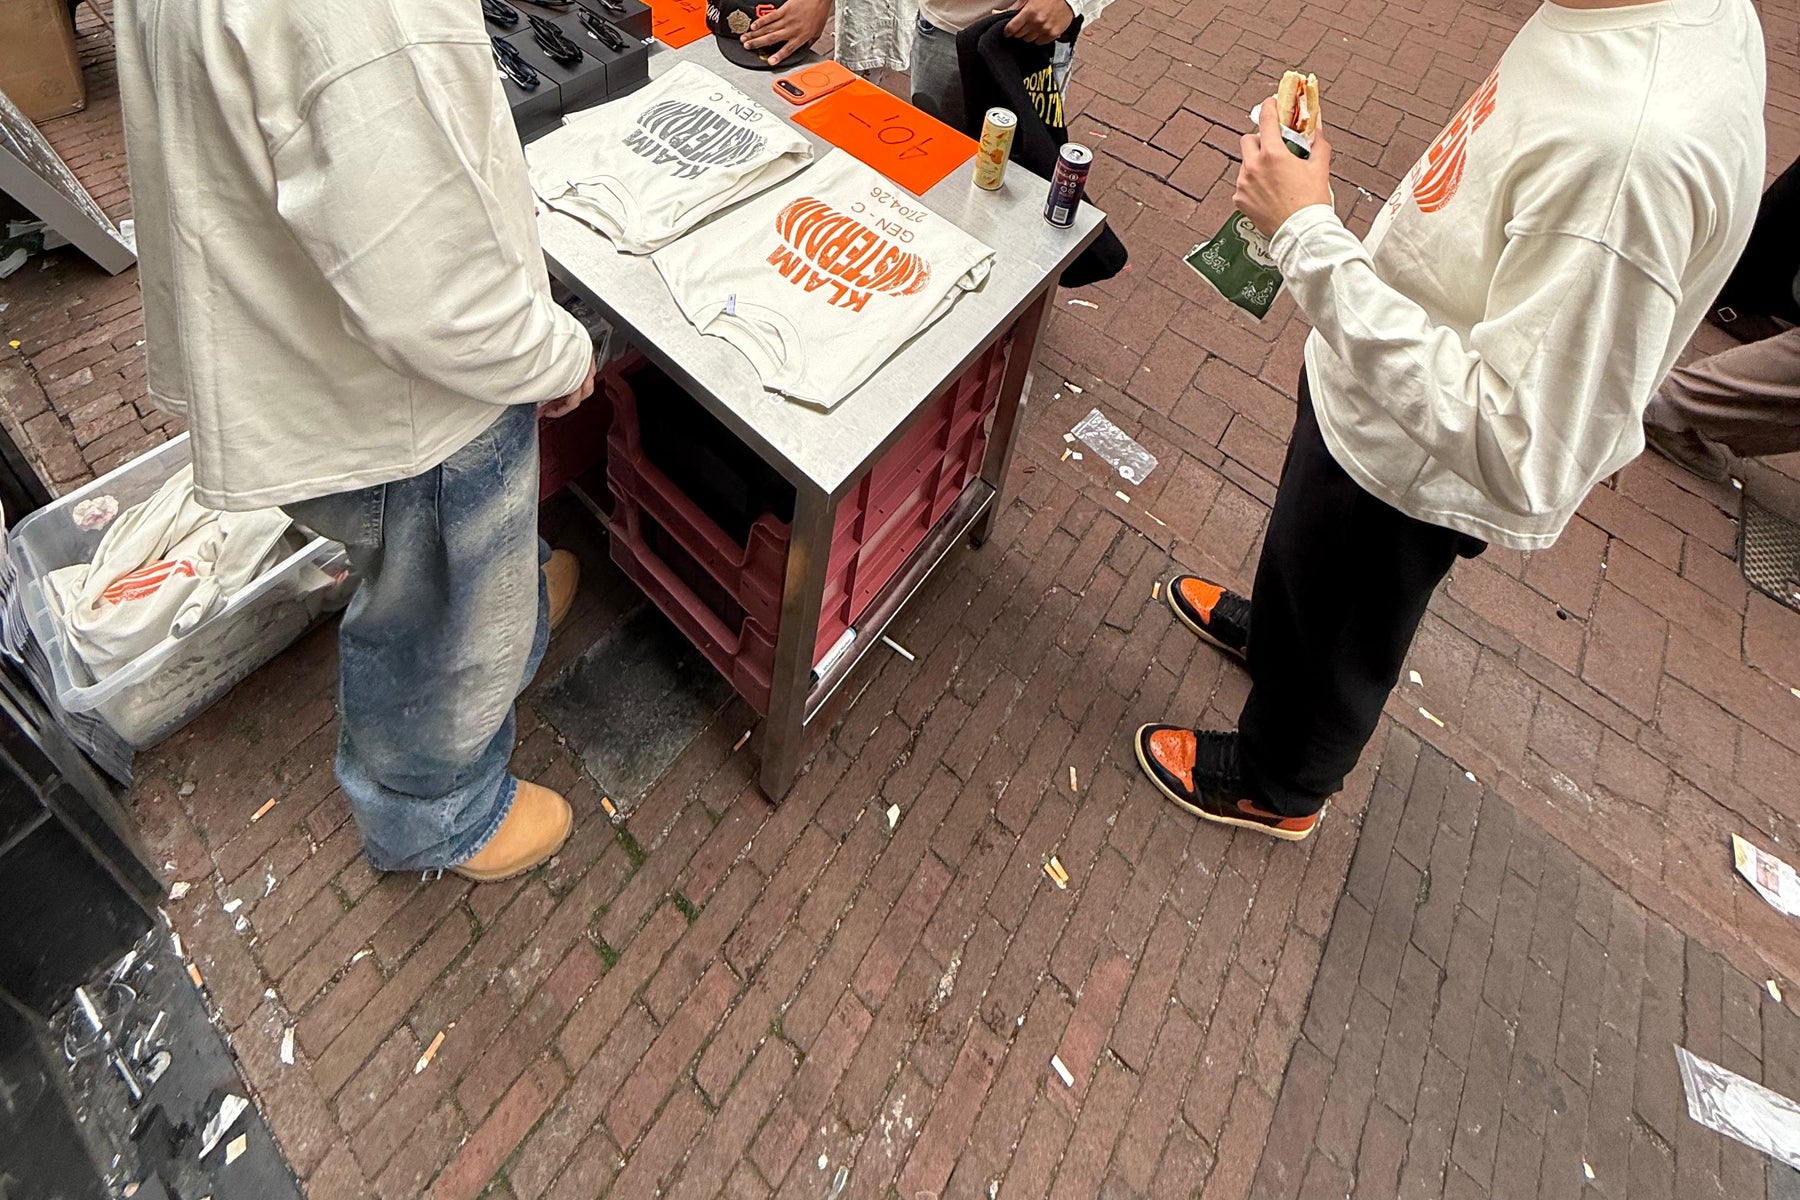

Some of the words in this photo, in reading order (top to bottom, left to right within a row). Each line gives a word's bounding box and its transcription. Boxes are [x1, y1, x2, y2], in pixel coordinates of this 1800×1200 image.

[708, 92, 724, 102] C
[729, 103, 763, 123] GEN
[621, 128, 710, 180] KLAIM
[851, 201, 866, 214] C
[870, 186, 929, 223] 27.04.26
[875, 217, 915, 244] GEN
[766, 244, 873, 313] KLAIM
